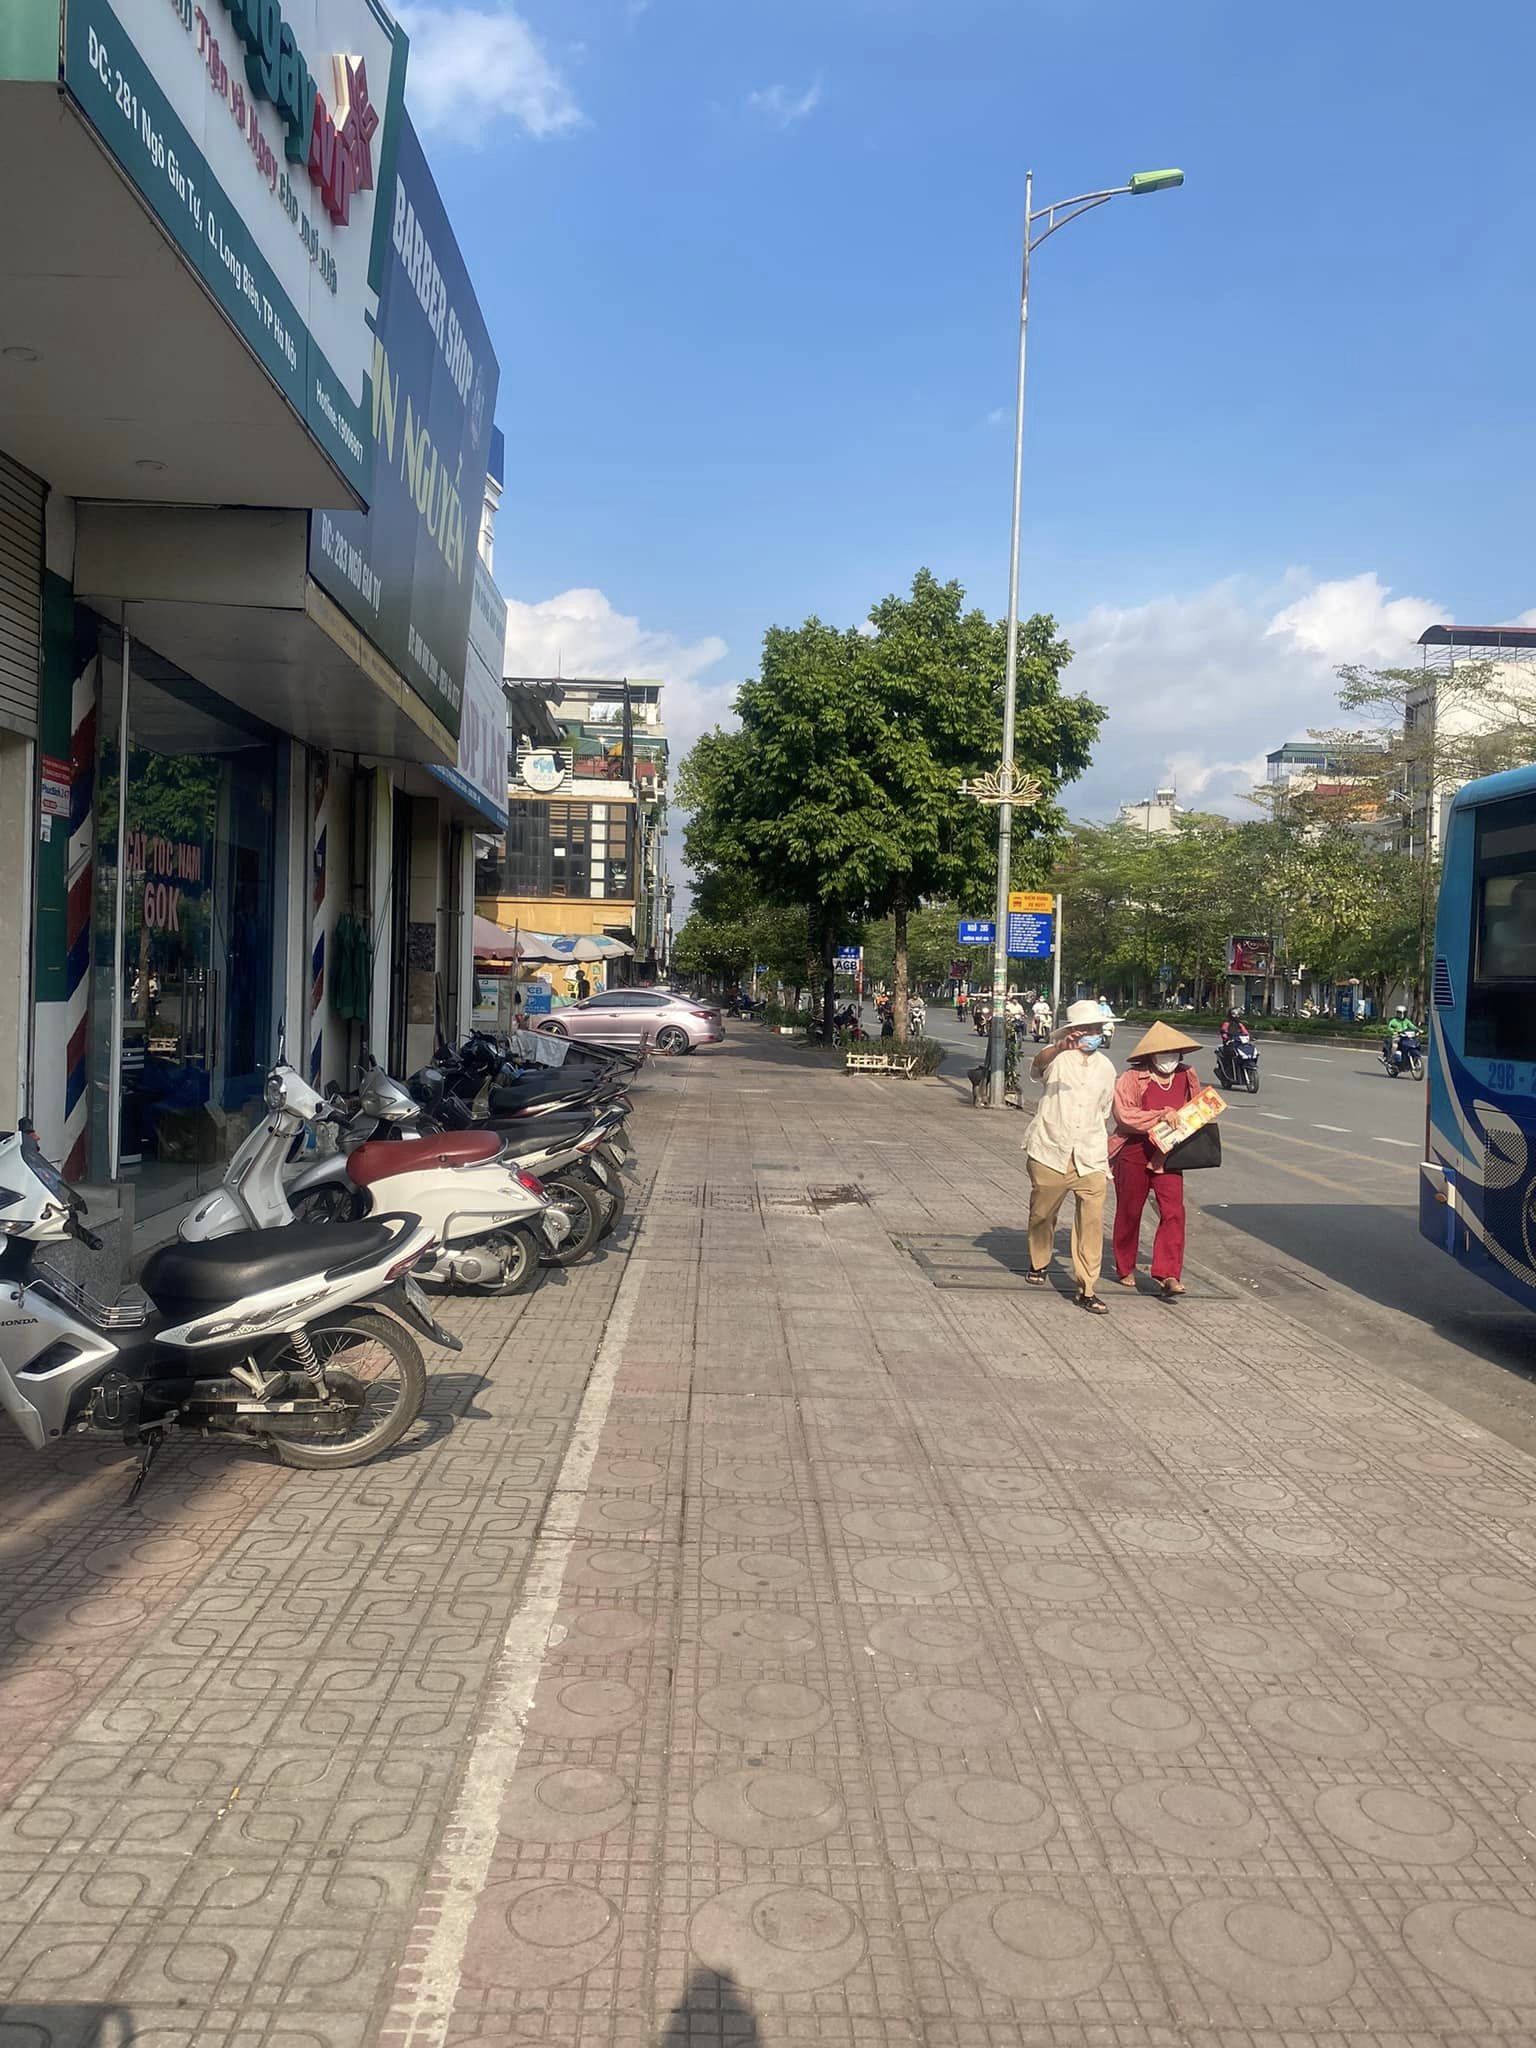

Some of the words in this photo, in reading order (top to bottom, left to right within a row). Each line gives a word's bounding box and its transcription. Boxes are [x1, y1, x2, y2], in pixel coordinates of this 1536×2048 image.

[88, 25, 112, 93] ĐC:
[115, 70, 138, 131] 281
[141, 107, 165, 169] Ngô
[167, 149, 186, 202] Gia
[187, 177, 202, 232] Tự,
[208, 211, 217, 250] Q.
[219, 228, 241, 290] Long
[242, 263, 261, 320] Biên,
[262, 295, 273, 329] TP
[274, 313, 284, 352] Hà
[285, 330, 297, 372] Nội
[279, 172, 298, 223] cho
[393, 172, 447, 350] BARBER
[445, 306, 473, 404] SHOP
[178, 842, 200, 881] NAM
[144, 881, 180, 933] 60K
